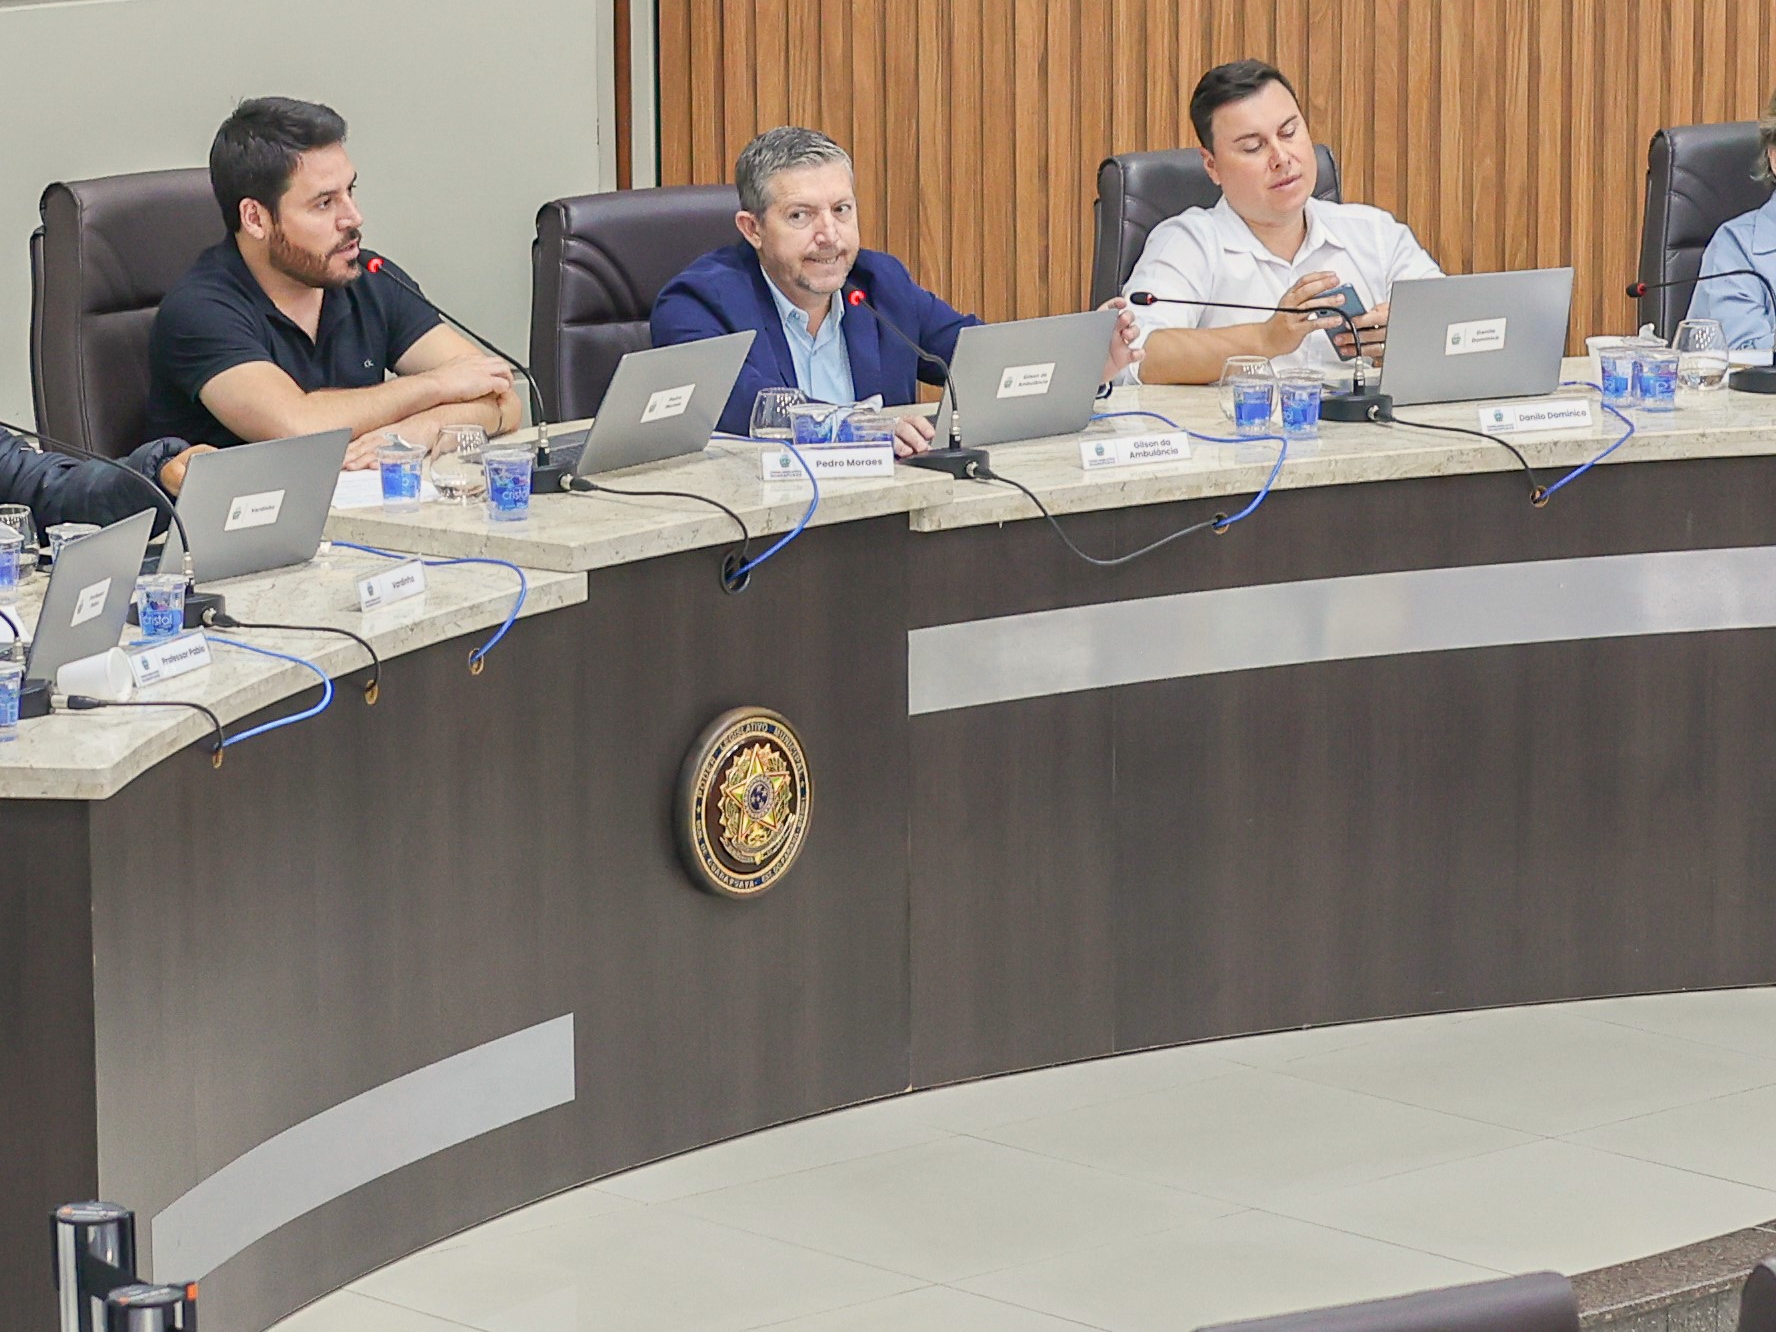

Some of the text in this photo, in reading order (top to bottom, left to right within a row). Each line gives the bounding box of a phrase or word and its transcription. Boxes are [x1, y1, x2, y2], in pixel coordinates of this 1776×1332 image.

[1519, 412, 1546, 422] Danilo
[1133, 439, 1171, 449] Gilson da
[1129, 447, 1179, 459] Ambulância
[816, 458, 883, 468] Pedro Moraes
[161, 650, 189, 665] Professor
